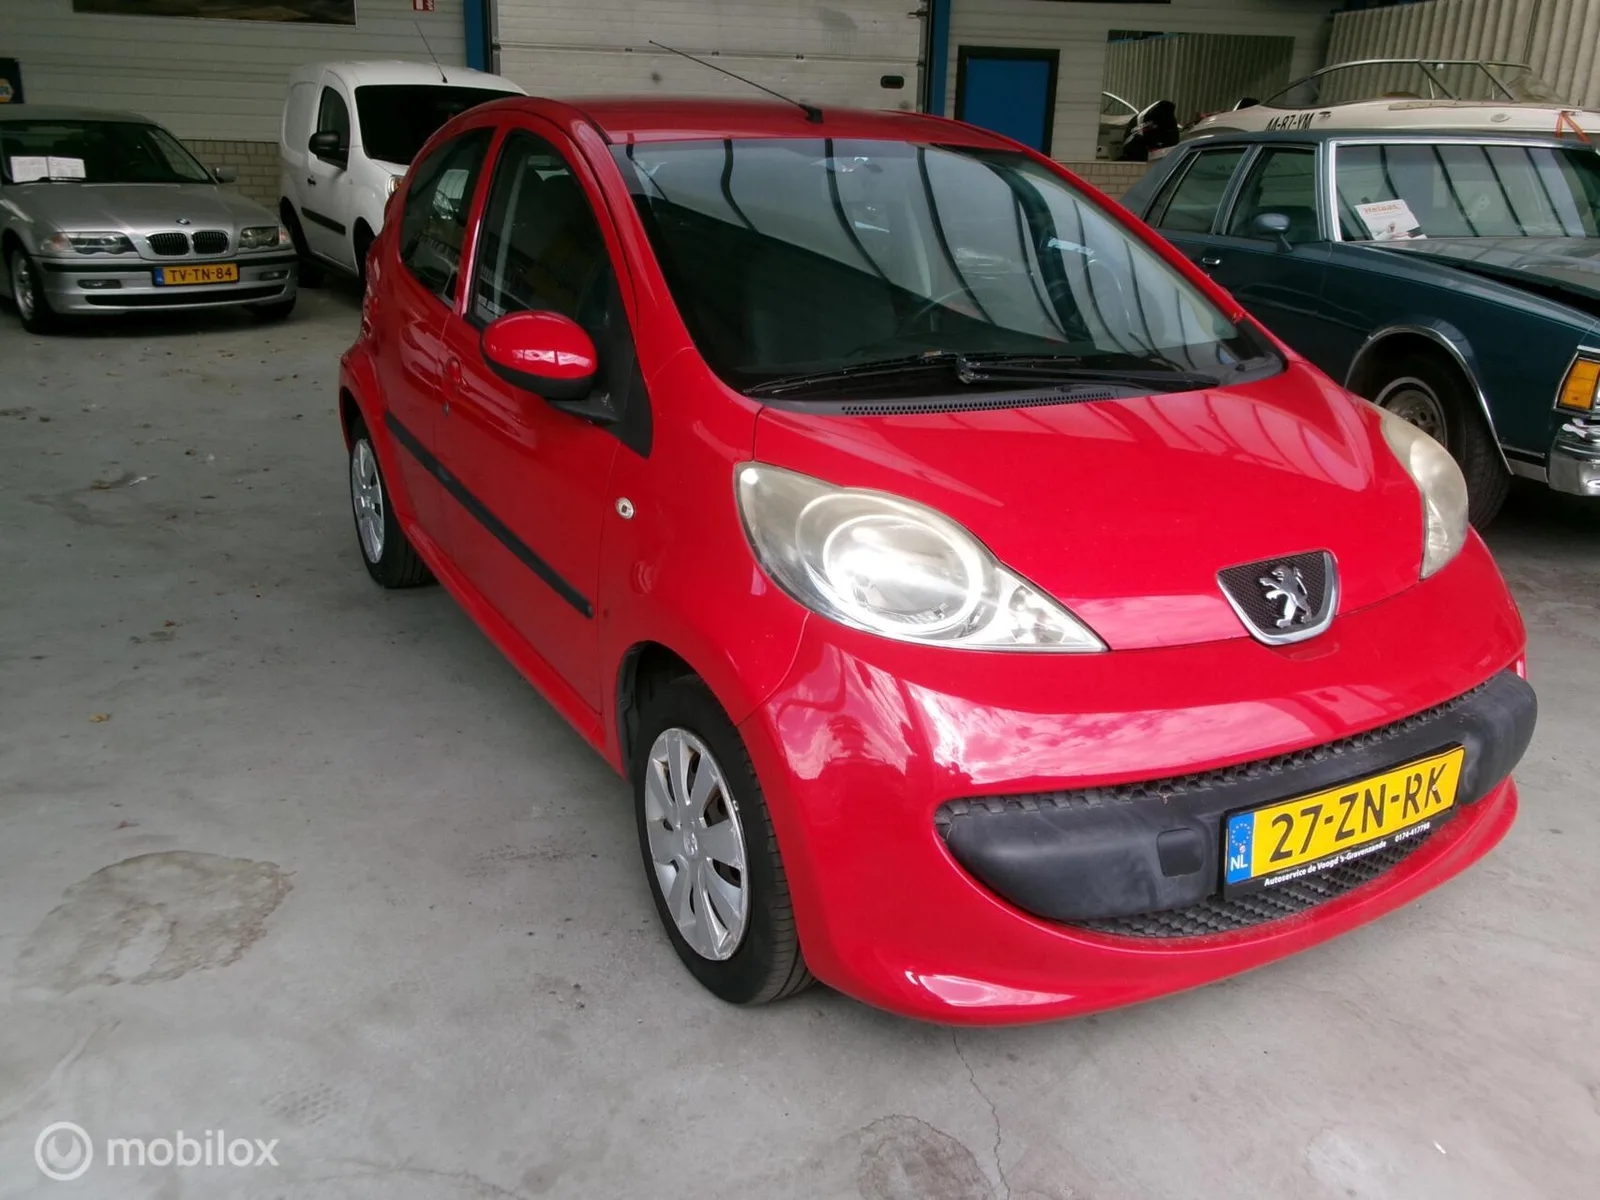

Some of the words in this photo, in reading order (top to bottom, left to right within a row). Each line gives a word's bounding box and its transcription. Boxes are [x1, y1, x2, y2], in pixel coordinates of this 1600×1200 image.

[169, 267, 233, 282] TV-TN-84
[1269, 763, 1447, 863] 27-ZN-RK
[1230, 856, 1249, 872] NL
[1264, 868, 1307, 887] Autoservice
[1307, 864, 1317, 874] de
[1316, 856, 1340, 871] Voogd
